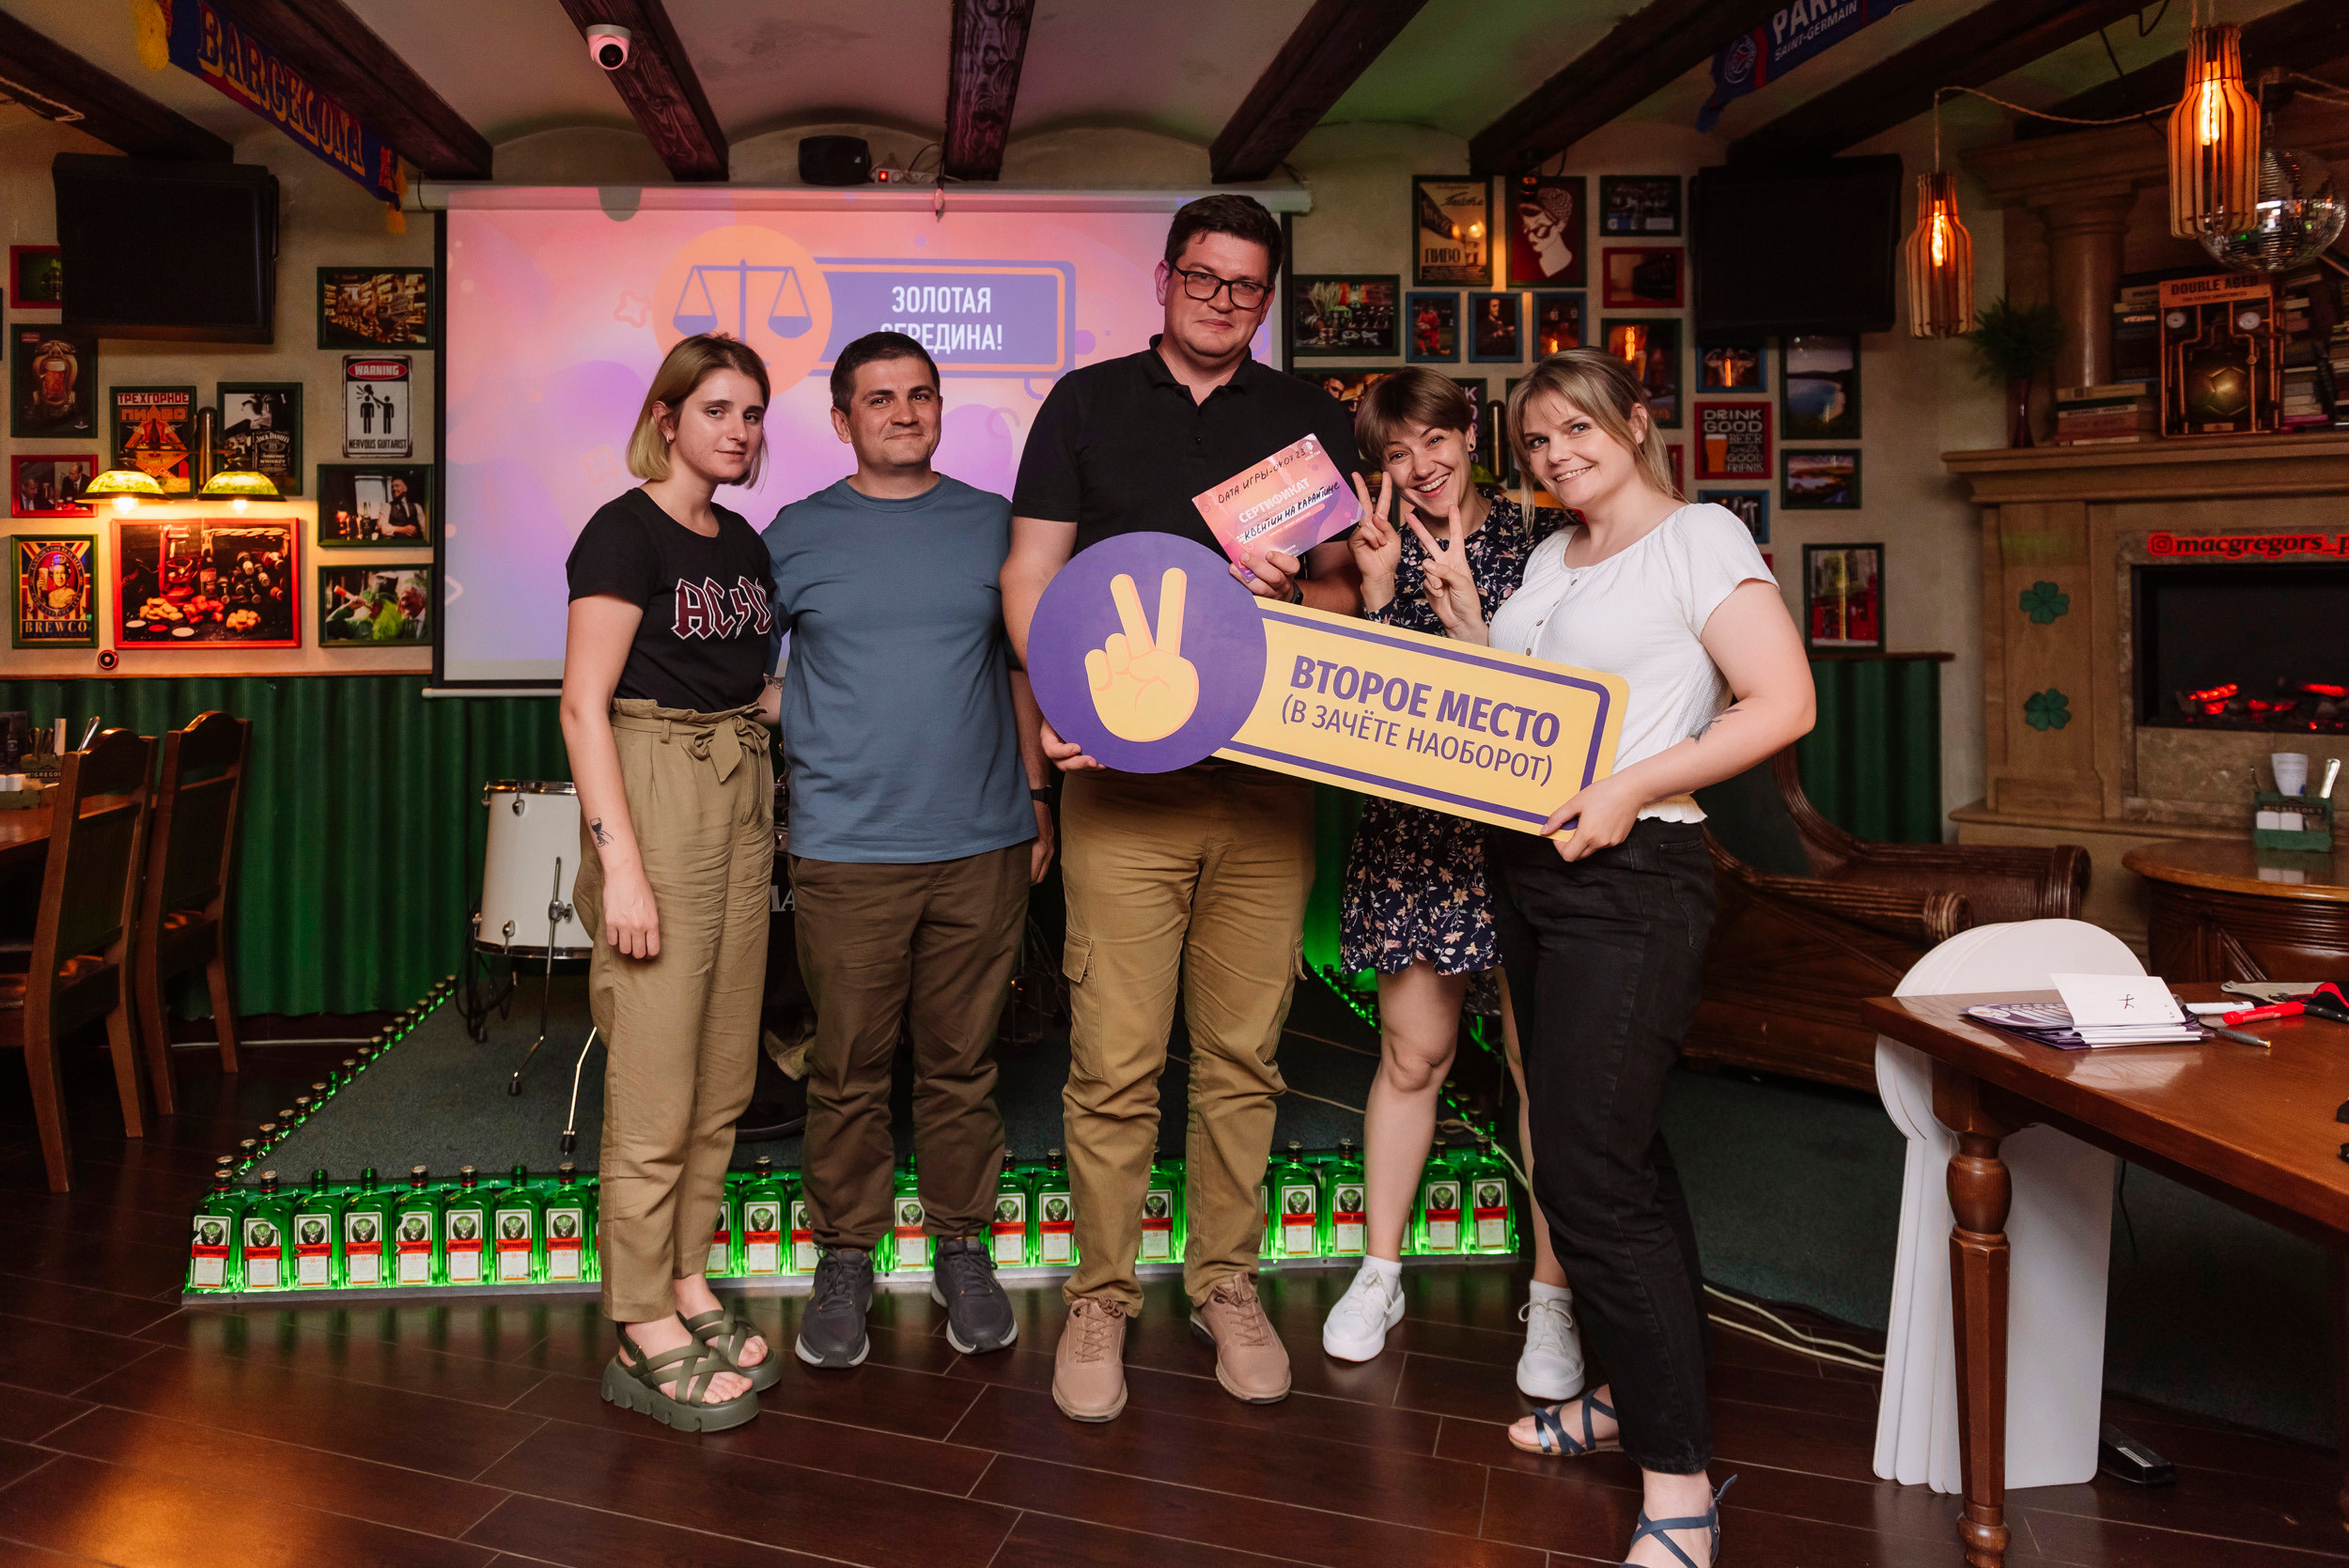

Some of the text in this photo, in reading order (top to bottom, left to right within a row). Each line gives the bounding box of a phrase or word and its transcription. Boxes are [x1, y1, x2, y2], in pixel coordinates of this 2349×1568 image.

[1772, 0, 1852, 45] PAR
[1775, 2, 1858, 61] SAINT-GERMAIN
[197, 1, 366, 177] BARCELONA
[1424, 248, 1461, 263] ПИВО
[2170, 280, 2220, 295] DOUBLE
[892, 286, 991, 313] ЗОЛОТАЯ
[355, 365, 399, 376] WARNING
[118, 393, 189, 403] ТРЕХГОРНОЕ
[1703, 409, 1762, 420] DRINK
[1703, 420, 1763, 432] GOOD
[349, 439, 407, 449] NERVOUS GUITARIST
[1729, 433, 1763, 443] BEER
[1727, 453, 1764, 462] GOOD
[1727, 462, 1765, 473] FRIENDS
[1238, 477, 1310, 523] СЕРТИФИКАТ
[1244, 514, 1283, 541] КВЕНТИН
[1284, 505, 1296, 519] НА
[25, 621, 87, 633] BREWCO
[1290, 655, 1561, 748] ВТОРОЕ МЕСТО
[1282, 693, 1553, 787] (В ЗАЧЁТЕ НАОБОРОТ)
